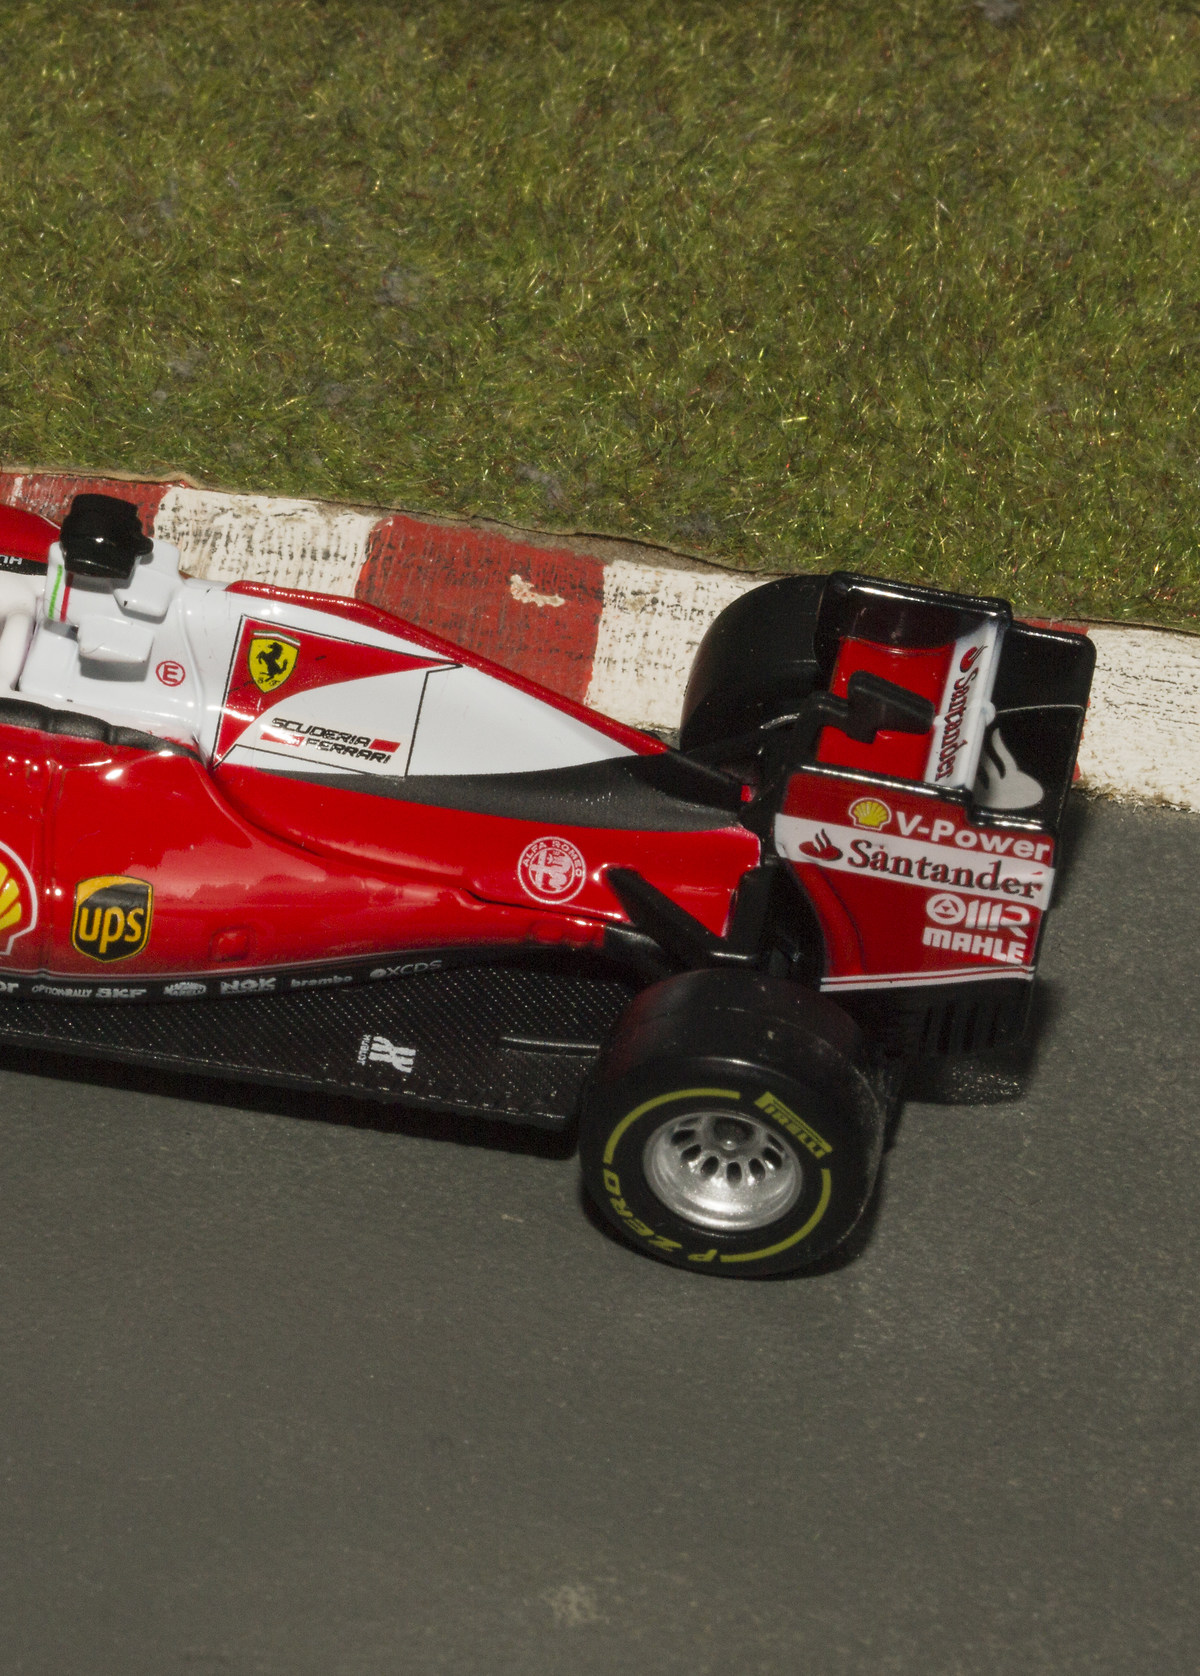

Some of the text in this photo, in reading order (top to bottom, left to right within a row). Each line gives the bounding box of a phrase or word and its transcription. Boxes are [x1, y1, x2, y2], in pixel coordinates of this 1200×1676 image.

[271, 717, 372, 748] SCUDERIA
[934, 667, 979, 783] Santander
[304, 737, 392, 764] FERRARI
[522, 840, 584, 878] ALFA ROMEO
[896, 811, 1051, 862] V-Power
[847, 838, 1042, 899] Santander
[78, 906, 145, 954] ups
[922, 926, 1027, 965] MAHLE
[95, 987, 147, 999] SKF
[753, 1090, 833, 1159] PIRELLI
[603, 1167, 683, 1252] ZERO
